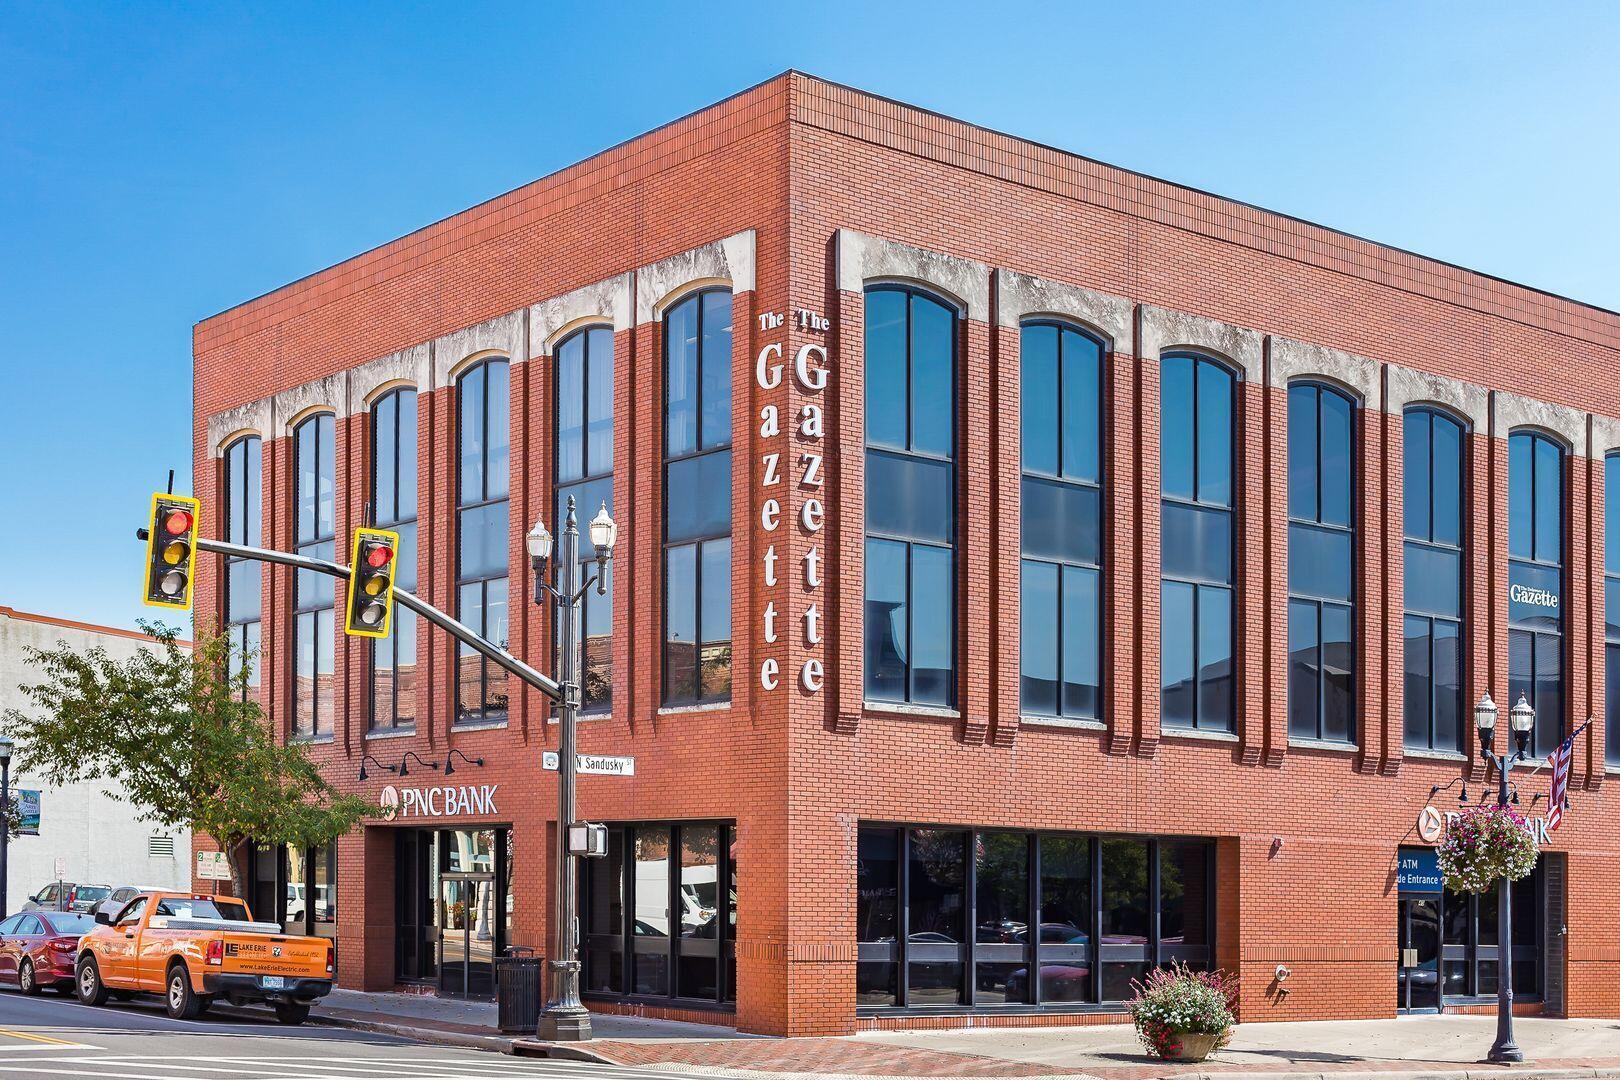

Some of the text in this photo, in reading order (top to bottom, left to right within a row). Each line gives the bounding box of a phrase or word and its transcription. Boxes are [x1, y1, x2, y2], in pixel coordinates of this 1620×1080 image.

[758, 311, 785, 332] The
[798, 308, 830, 331] The
[756, 342, 785, 691] Gazette
[795, 343, 831, 692] Gazette
[1510, 584, 1558, 608] Gazette
[576, 757, 582, 769] N
[585, 757, 624, 774] Sandusky
[1402, 859, 1419, 870] ATM
[1407, 874, 1439, 885] Entrance
[239, 944, 267, 953] LAKE ERIE
[240, 963, 311, 973] www.LakeErieElectric.com
